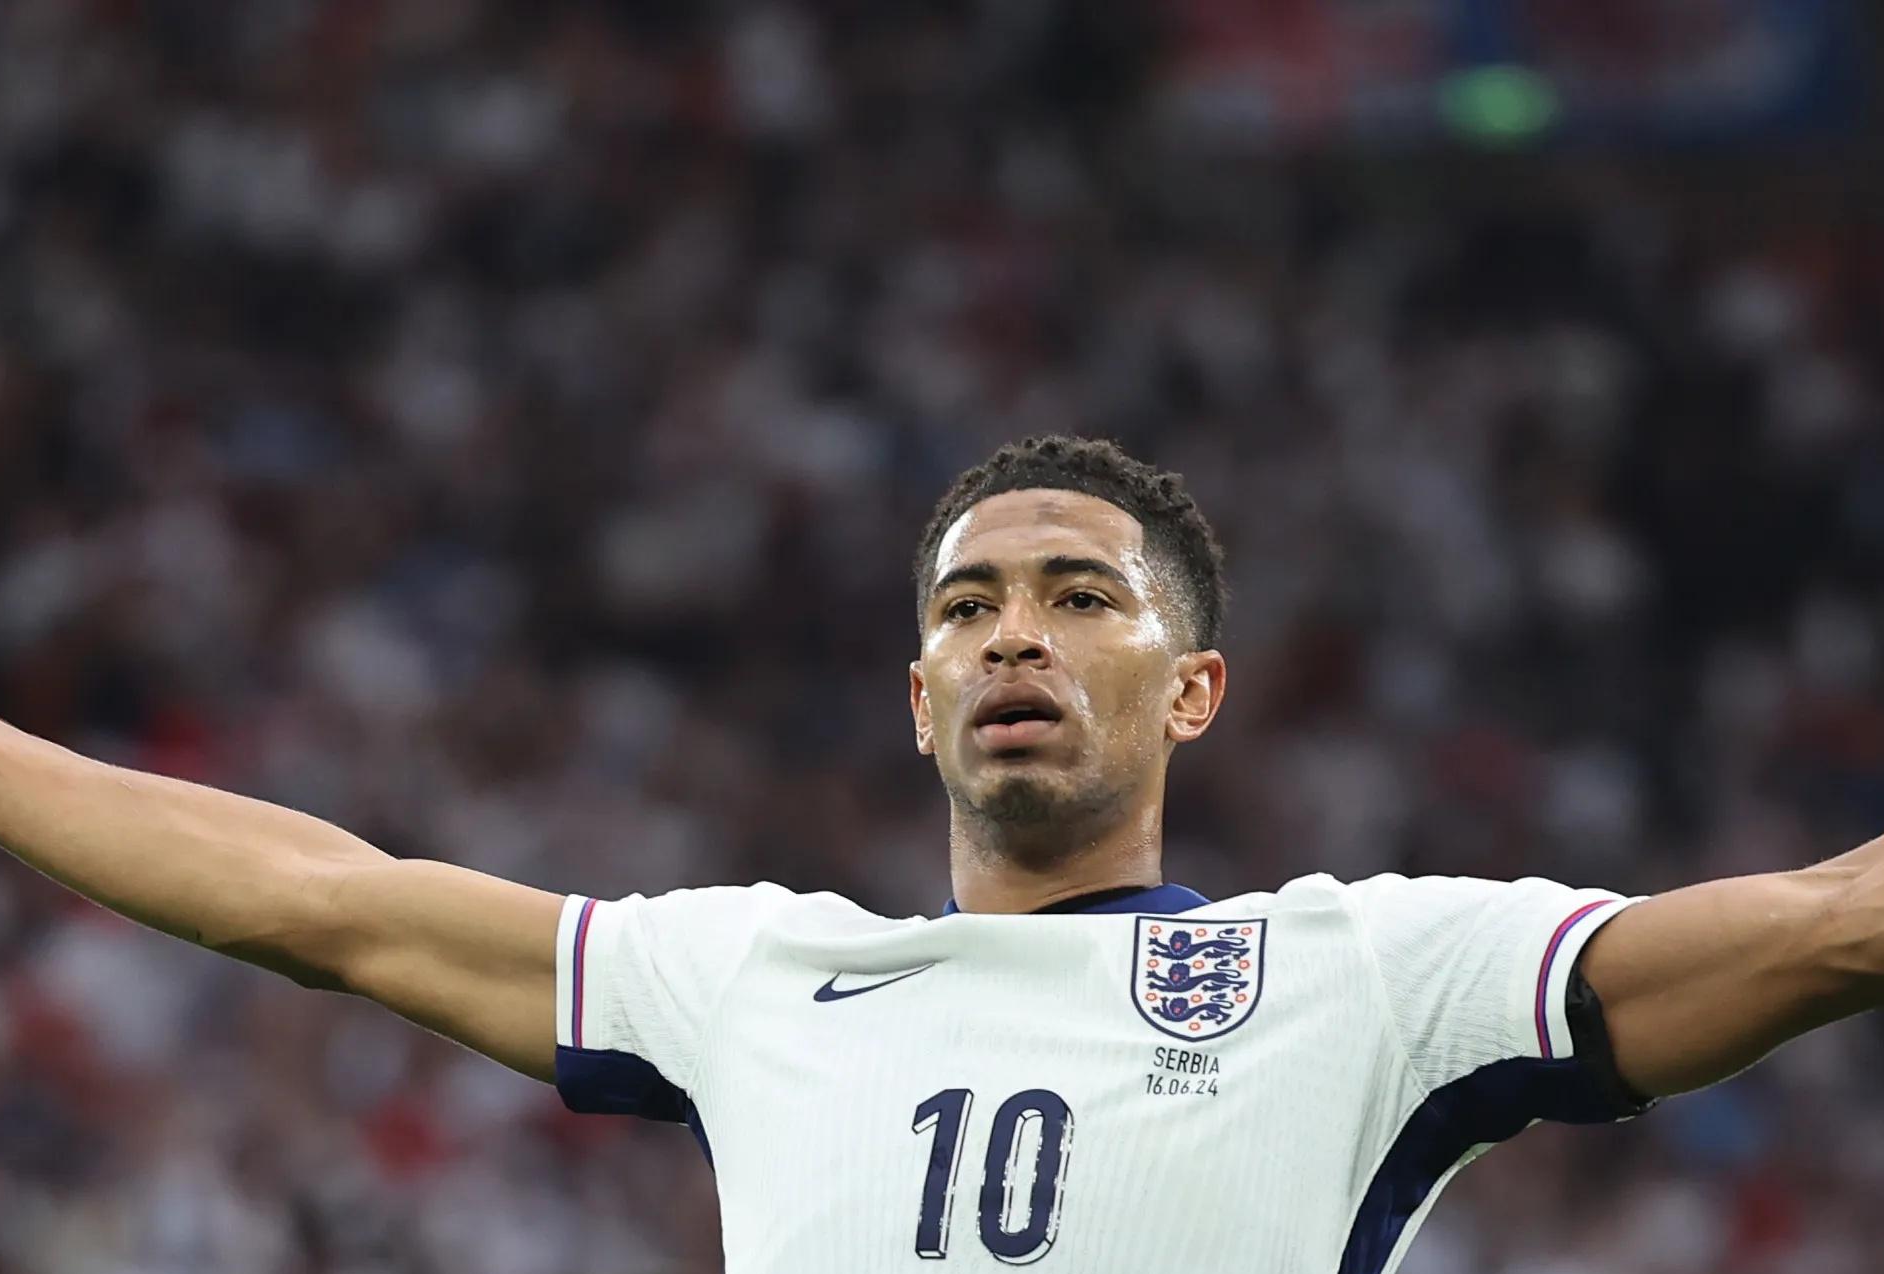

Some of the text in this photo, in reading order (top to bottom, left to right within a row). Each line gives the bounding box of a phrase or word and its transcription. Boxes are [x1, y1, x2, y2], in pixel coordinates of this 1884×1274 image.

[1152, 1046, 1220, 1075] SERBIA
[1145, 1074, 1219, 1097] 16.06.24
[911, 1087, 1076, 1267] 10
